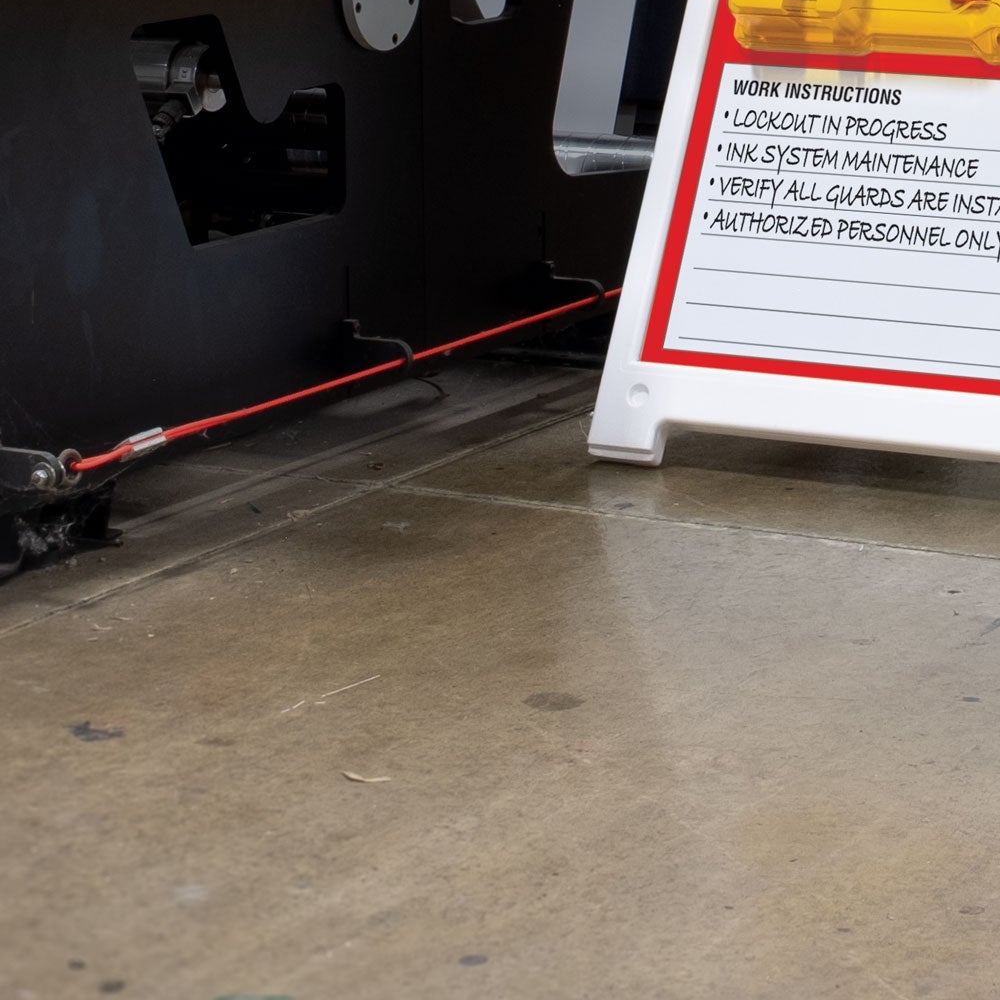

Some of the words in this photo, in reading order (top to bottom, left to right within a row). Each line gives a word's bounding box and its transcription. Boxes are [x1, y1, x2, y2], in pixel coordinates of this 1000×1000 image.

[734, 80, 781, 97] WORK
[785, 83, 901, 105] INSTRUCTIONS
[734, 109, 821, 133] LOCKOUT
[823, 115, 841, 135] IN
[846, 116, 947, 144] PROGRESS
[727, 143, 758, 163] INK
[761, 145, 838, 174] SYSTEM
[842, 151, 979, 178] MAINTENANCE
[720, 177, 784, 209] VERIFY
[784, 180, 821, 201] ALL
[826, 185, 905, 210] GUARDS
[908, 190, 949, 211] ARE
[710, 209, 832, 238] AUTHORIZED
[838, 219, 950, 246] PERSONNEL
